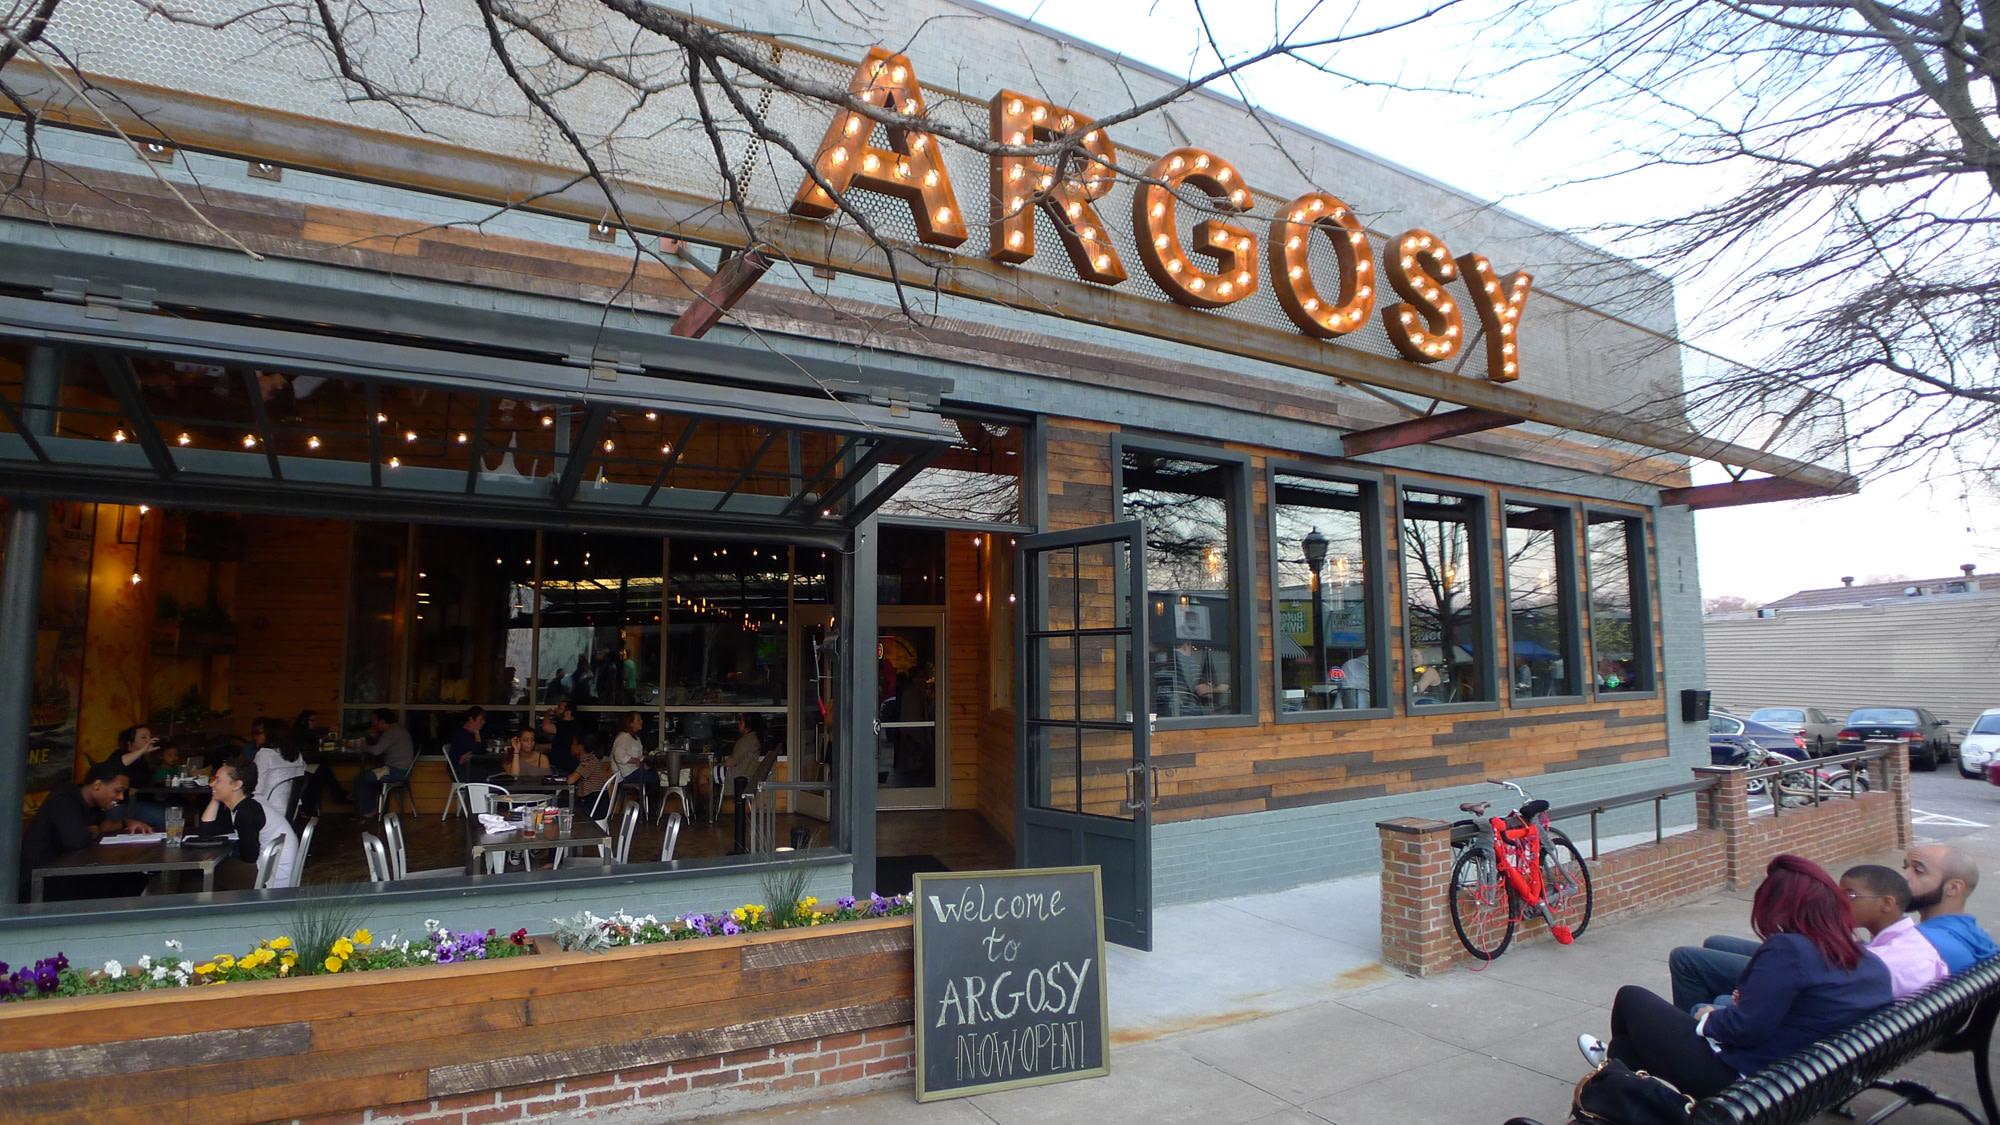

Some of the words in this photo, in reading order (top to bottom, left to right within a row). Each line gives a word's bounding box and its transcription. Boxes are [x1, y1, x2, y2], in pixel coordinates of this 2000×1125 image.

[790, 46, 1534, 383] ARGOSY
[929, 883, 1066, 923] Welcome
[982, 927, 1021, 962] to
[936, 958, 1092, 1028] ARGOSY
[955, 1028, 1016, 1080] NOW
[1018, 1020, 1084, 1073] OPEN!
